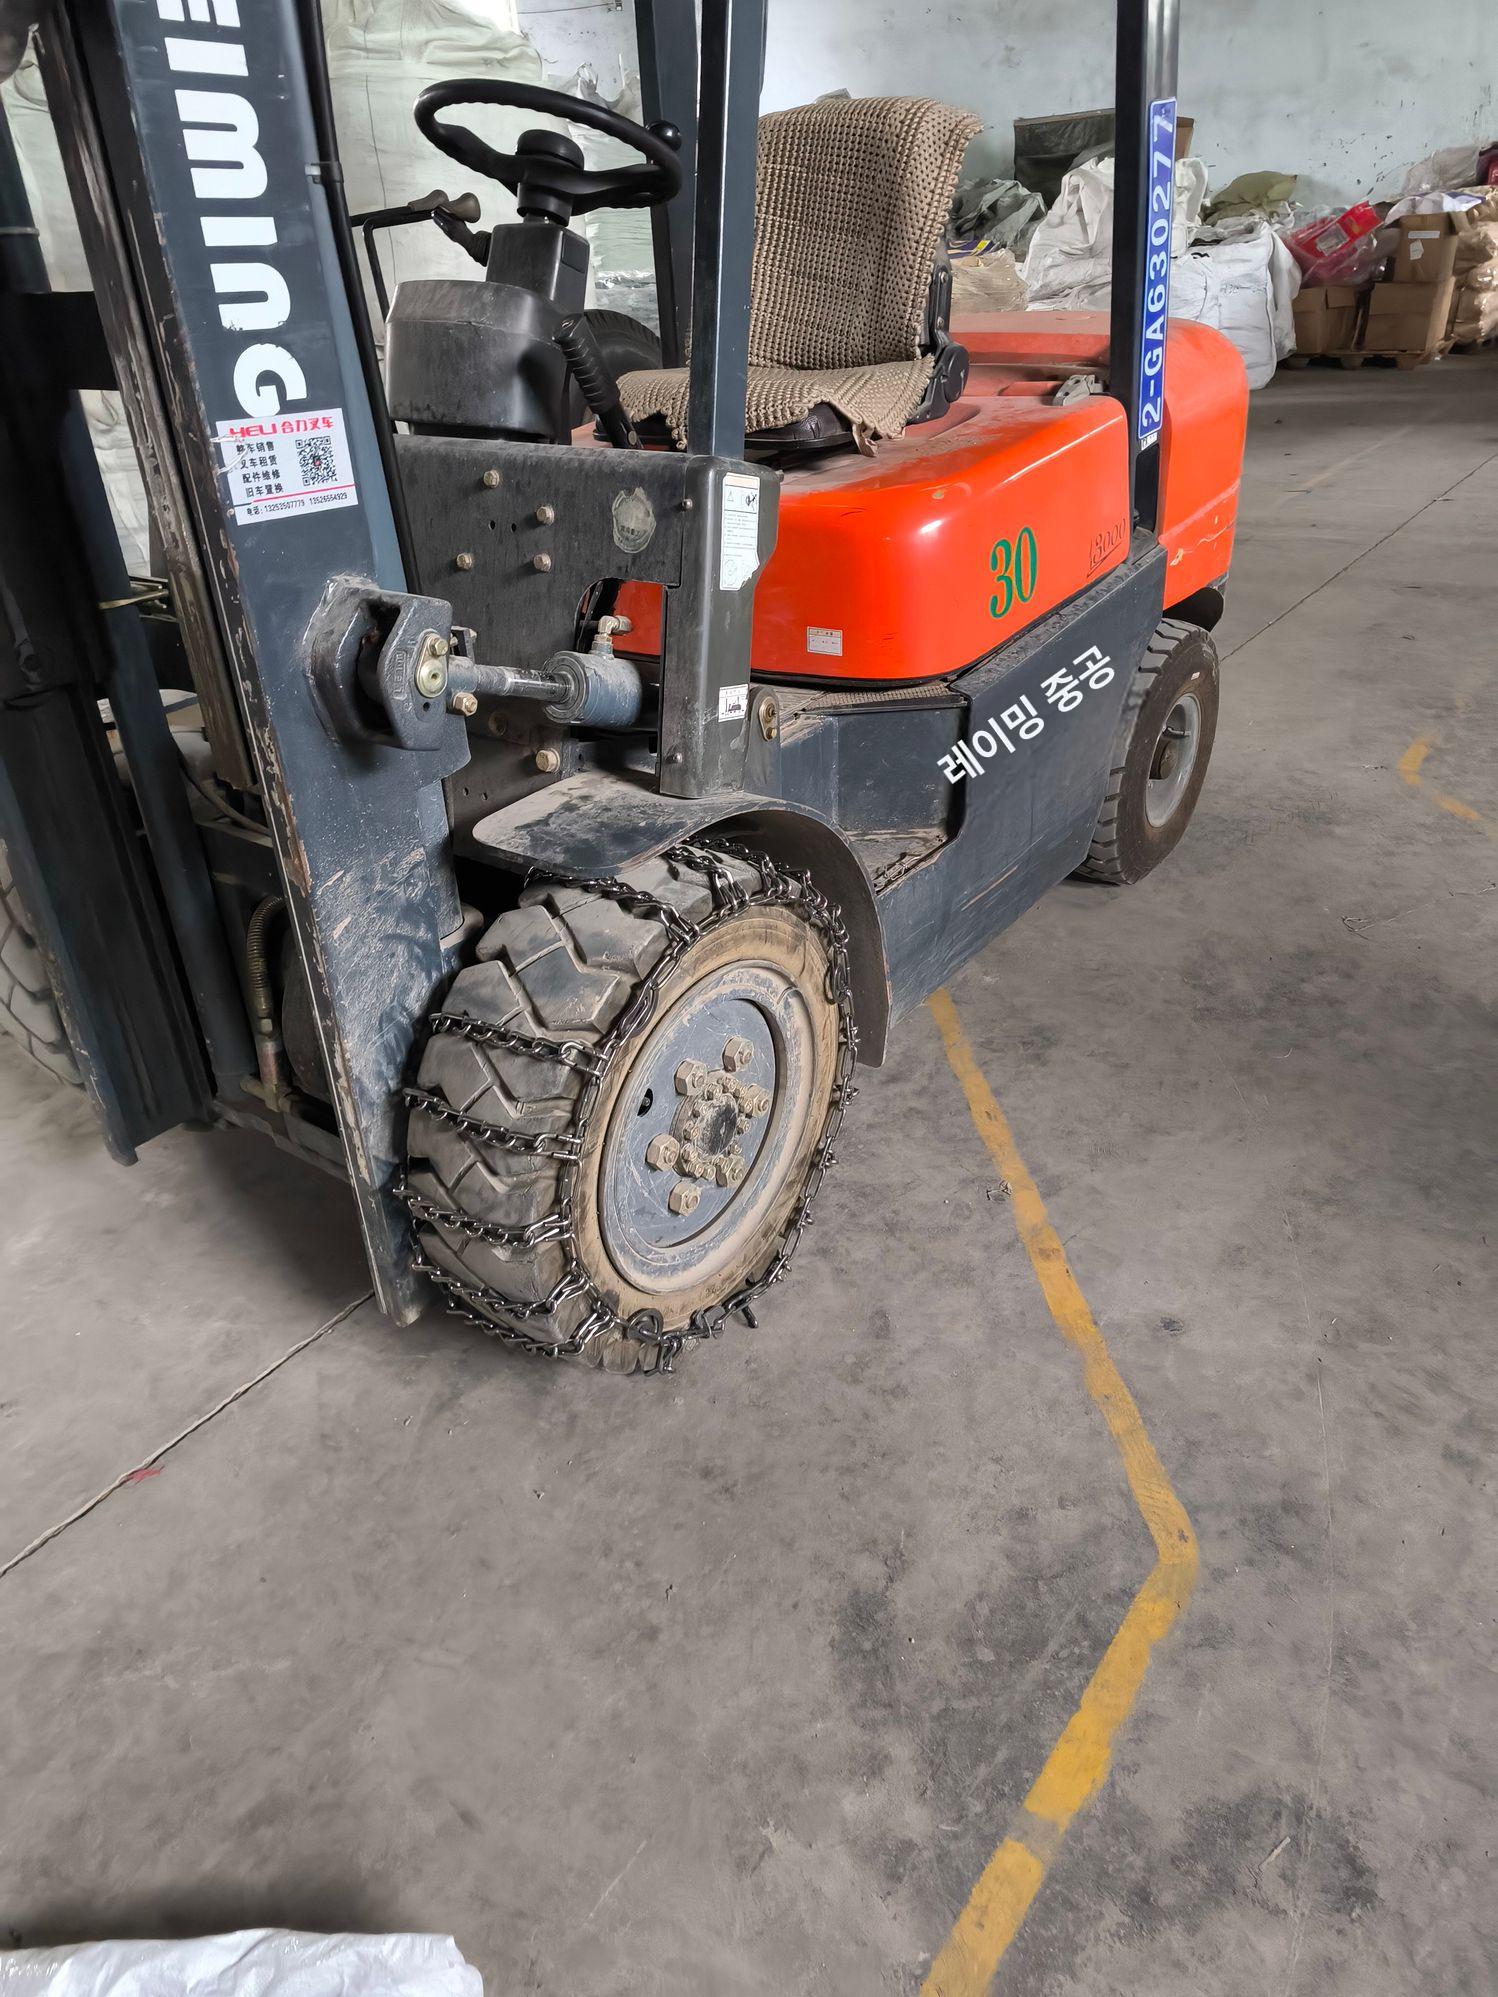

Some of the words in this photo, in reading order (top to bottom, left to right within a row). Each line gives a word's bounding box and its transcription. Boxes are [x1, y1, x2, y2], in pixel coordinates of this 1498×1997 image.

[1143, 114, 1173, 427] 2-GA630277
[229, 423, 277, 438] HELI
[281, 416, 334, 434] 合力叉车
[240, 454, 278, 470] 叉车租赁
[242, 468, 281, 484] 配件维修
[245, 482, 284, 498] 旧车置换
[989, 526, 1038, 619] 30
[936, 694, 1045, 785] 레이밍
[1040, 645, 1115, 713] 중공
